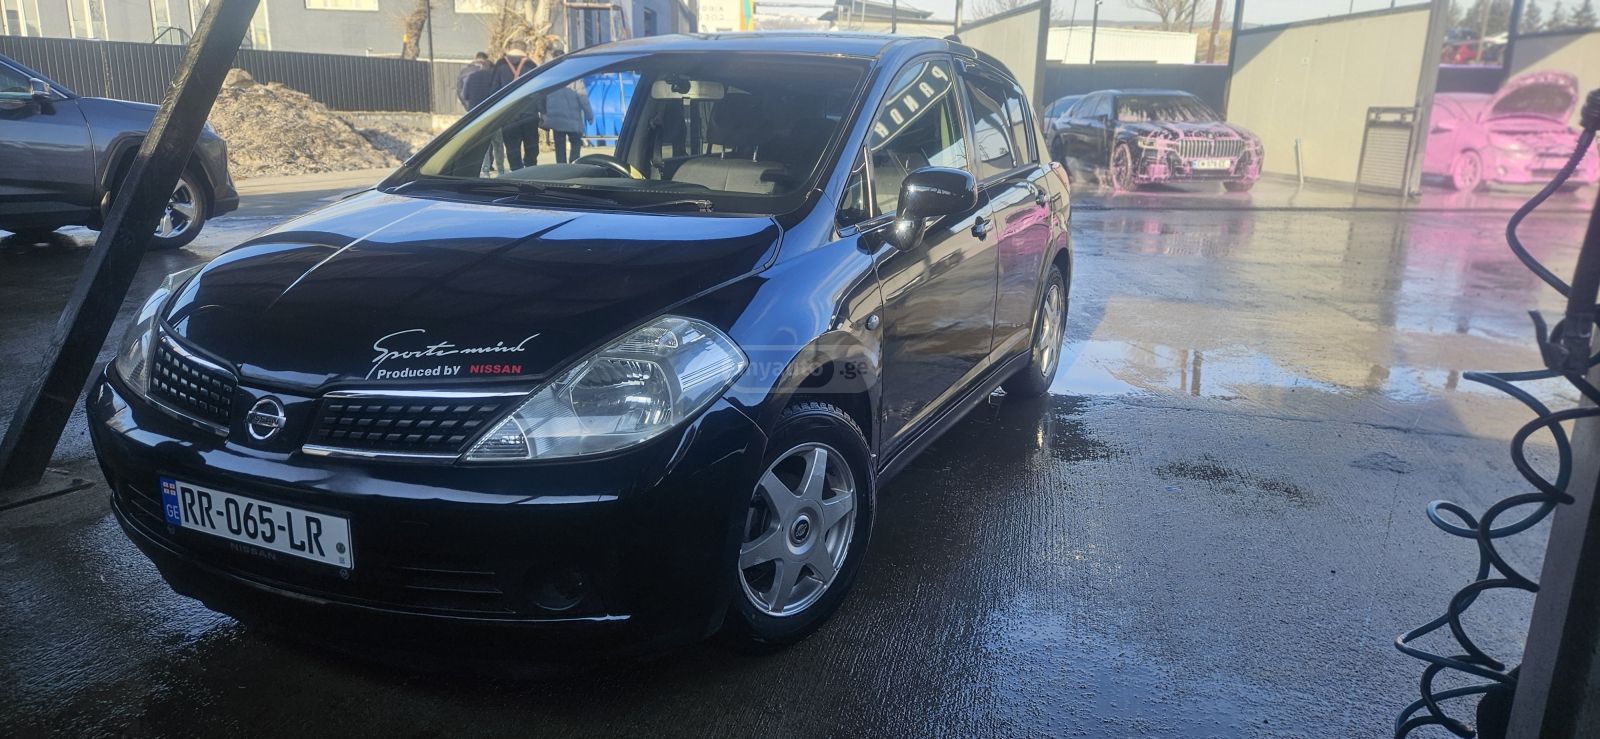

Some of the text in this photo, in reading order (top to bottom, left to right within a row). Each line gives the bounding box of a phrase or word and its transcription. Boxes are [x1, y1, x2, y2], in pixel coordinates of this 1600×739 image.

[377, 365, 522, 379] Produced by NISSAN
[166, 503, 180, 520] GE
[180, 487, 325, 557] RR-065-LR
[230, 542, 277, 560] NISSAN
